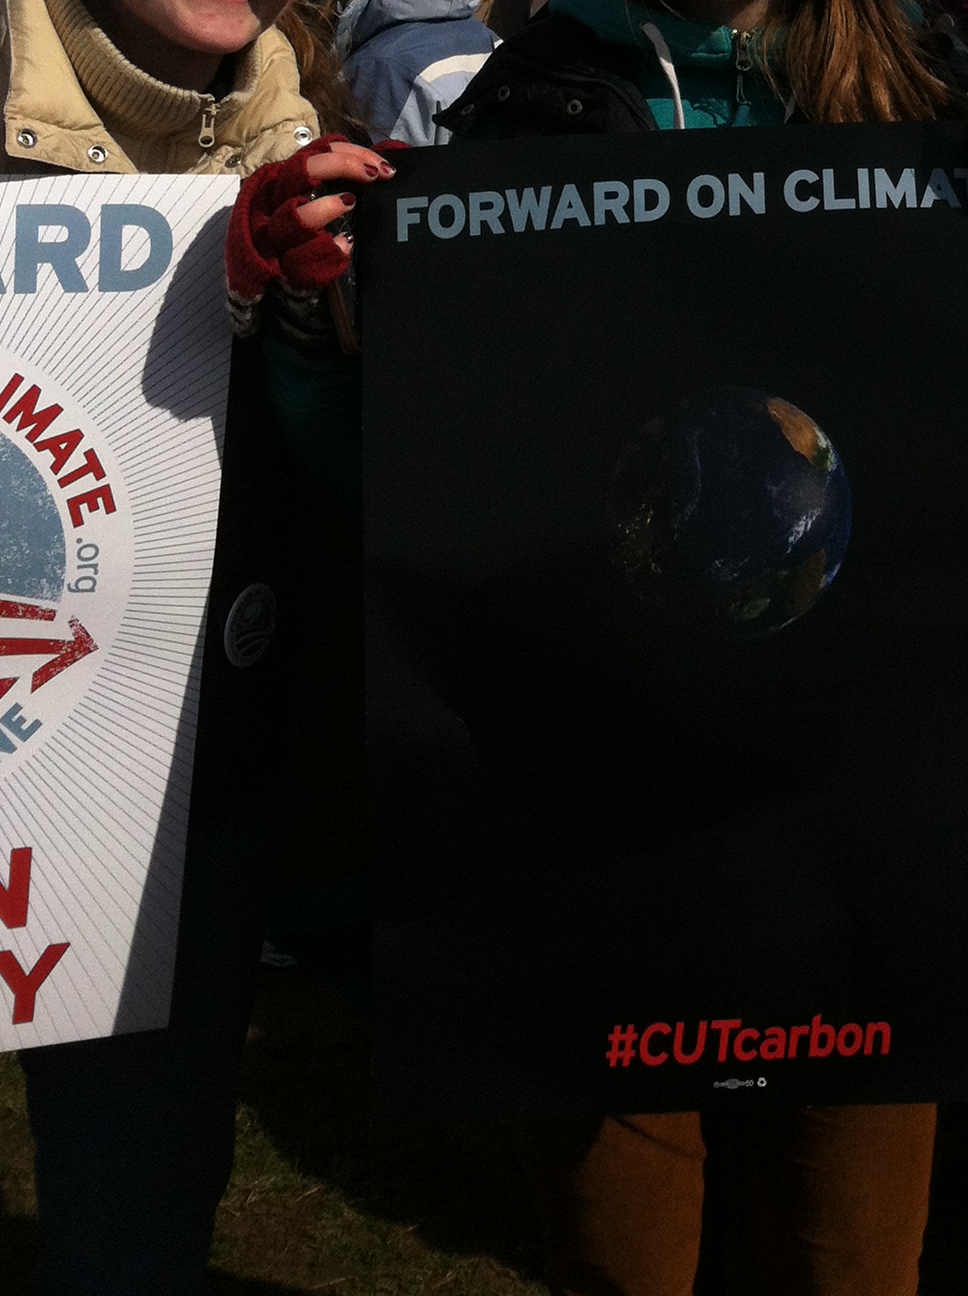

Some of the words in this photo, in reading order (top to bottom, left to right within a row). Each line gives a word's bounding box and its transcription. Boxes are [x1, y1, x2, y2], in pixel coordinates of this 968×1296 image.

[396, 178, 671, 242] FORWARD
[686, 171, 767, 219] ON
[0, 203, 174, 295] RD
[605, 1013, 892, 1068] #CUTcarbon
